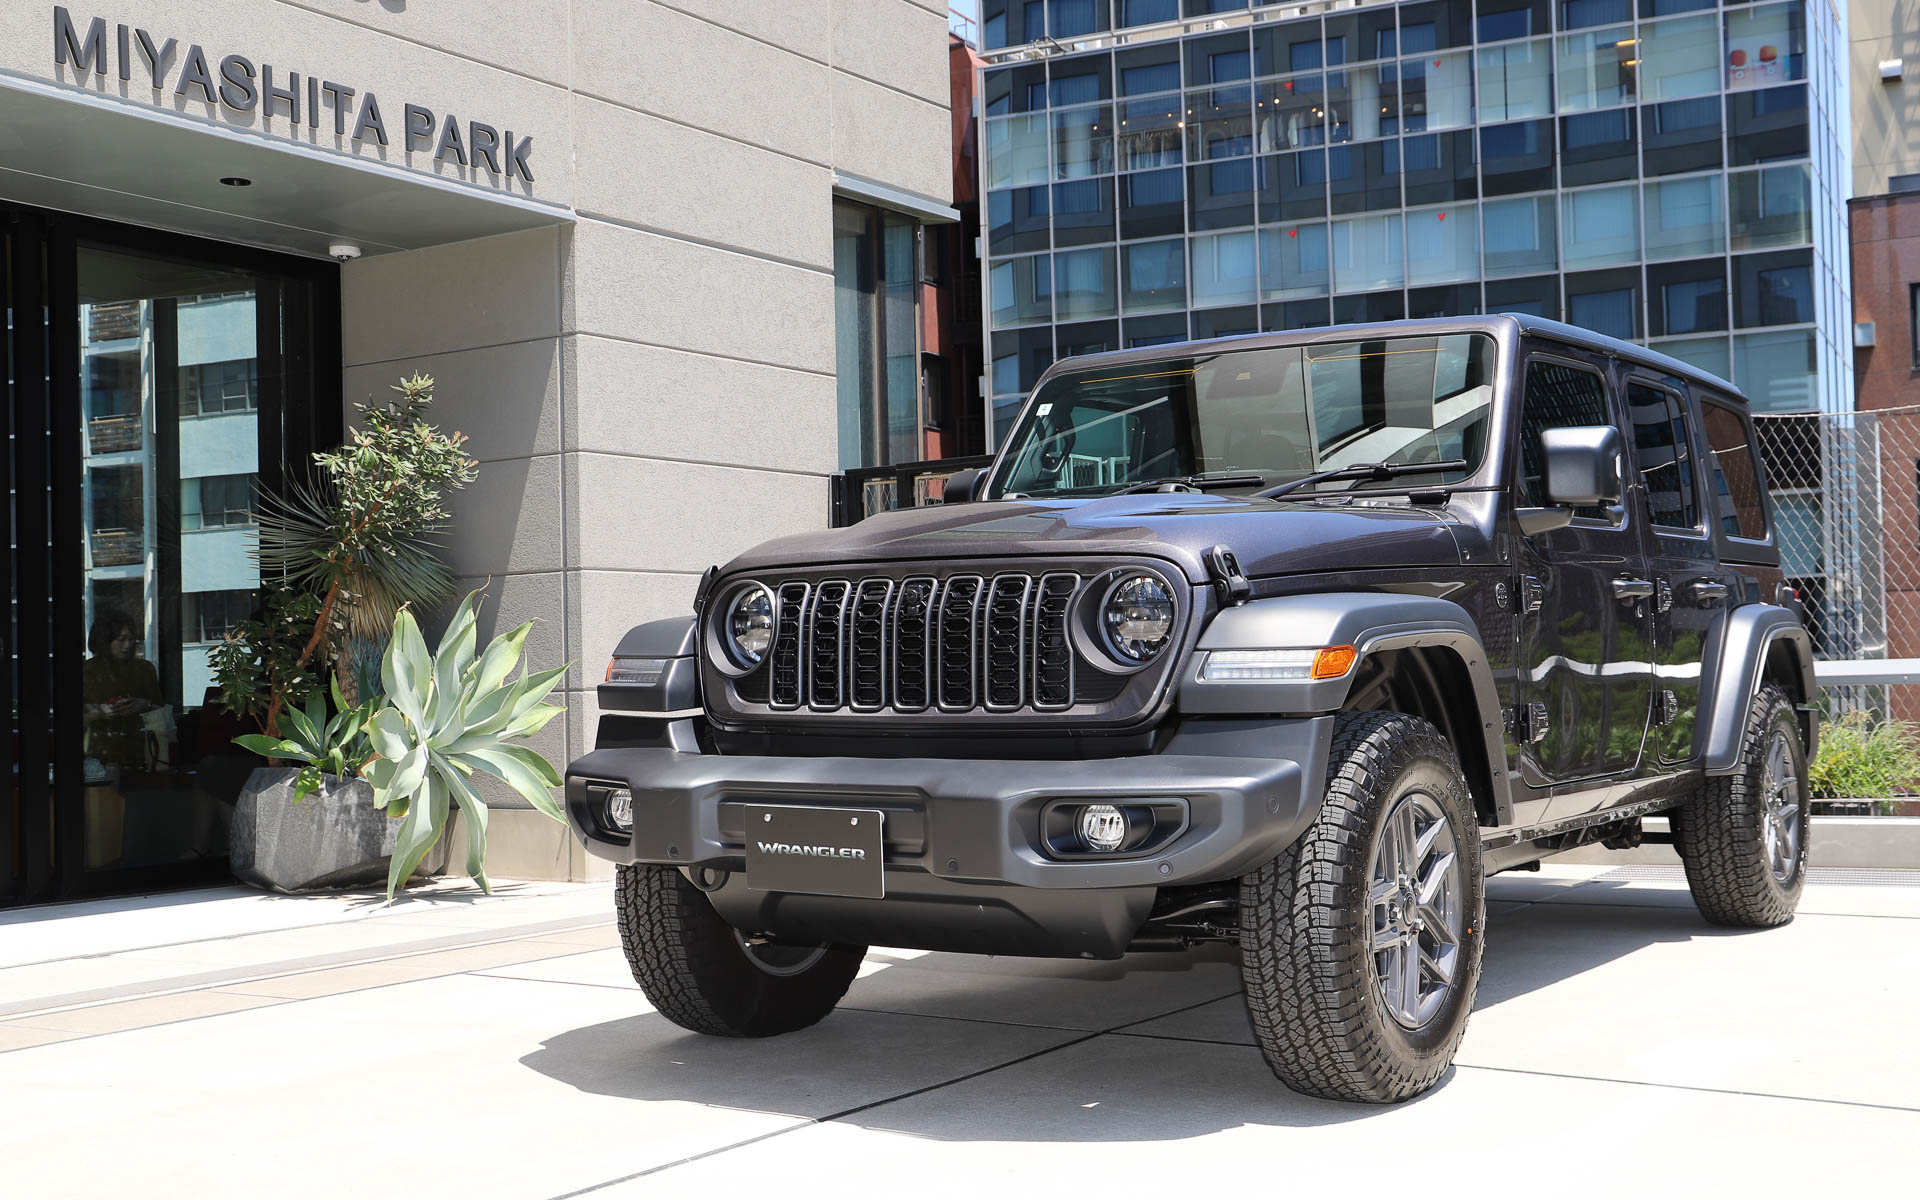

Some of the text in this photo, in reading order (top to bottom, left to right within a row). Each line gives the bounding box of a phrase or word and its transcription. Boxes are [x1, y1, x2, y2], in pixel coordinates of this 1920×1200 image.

[53, 6, 535, 182] MIYASHITA PARK
[757, 841, 866, 860] WRANGLER
